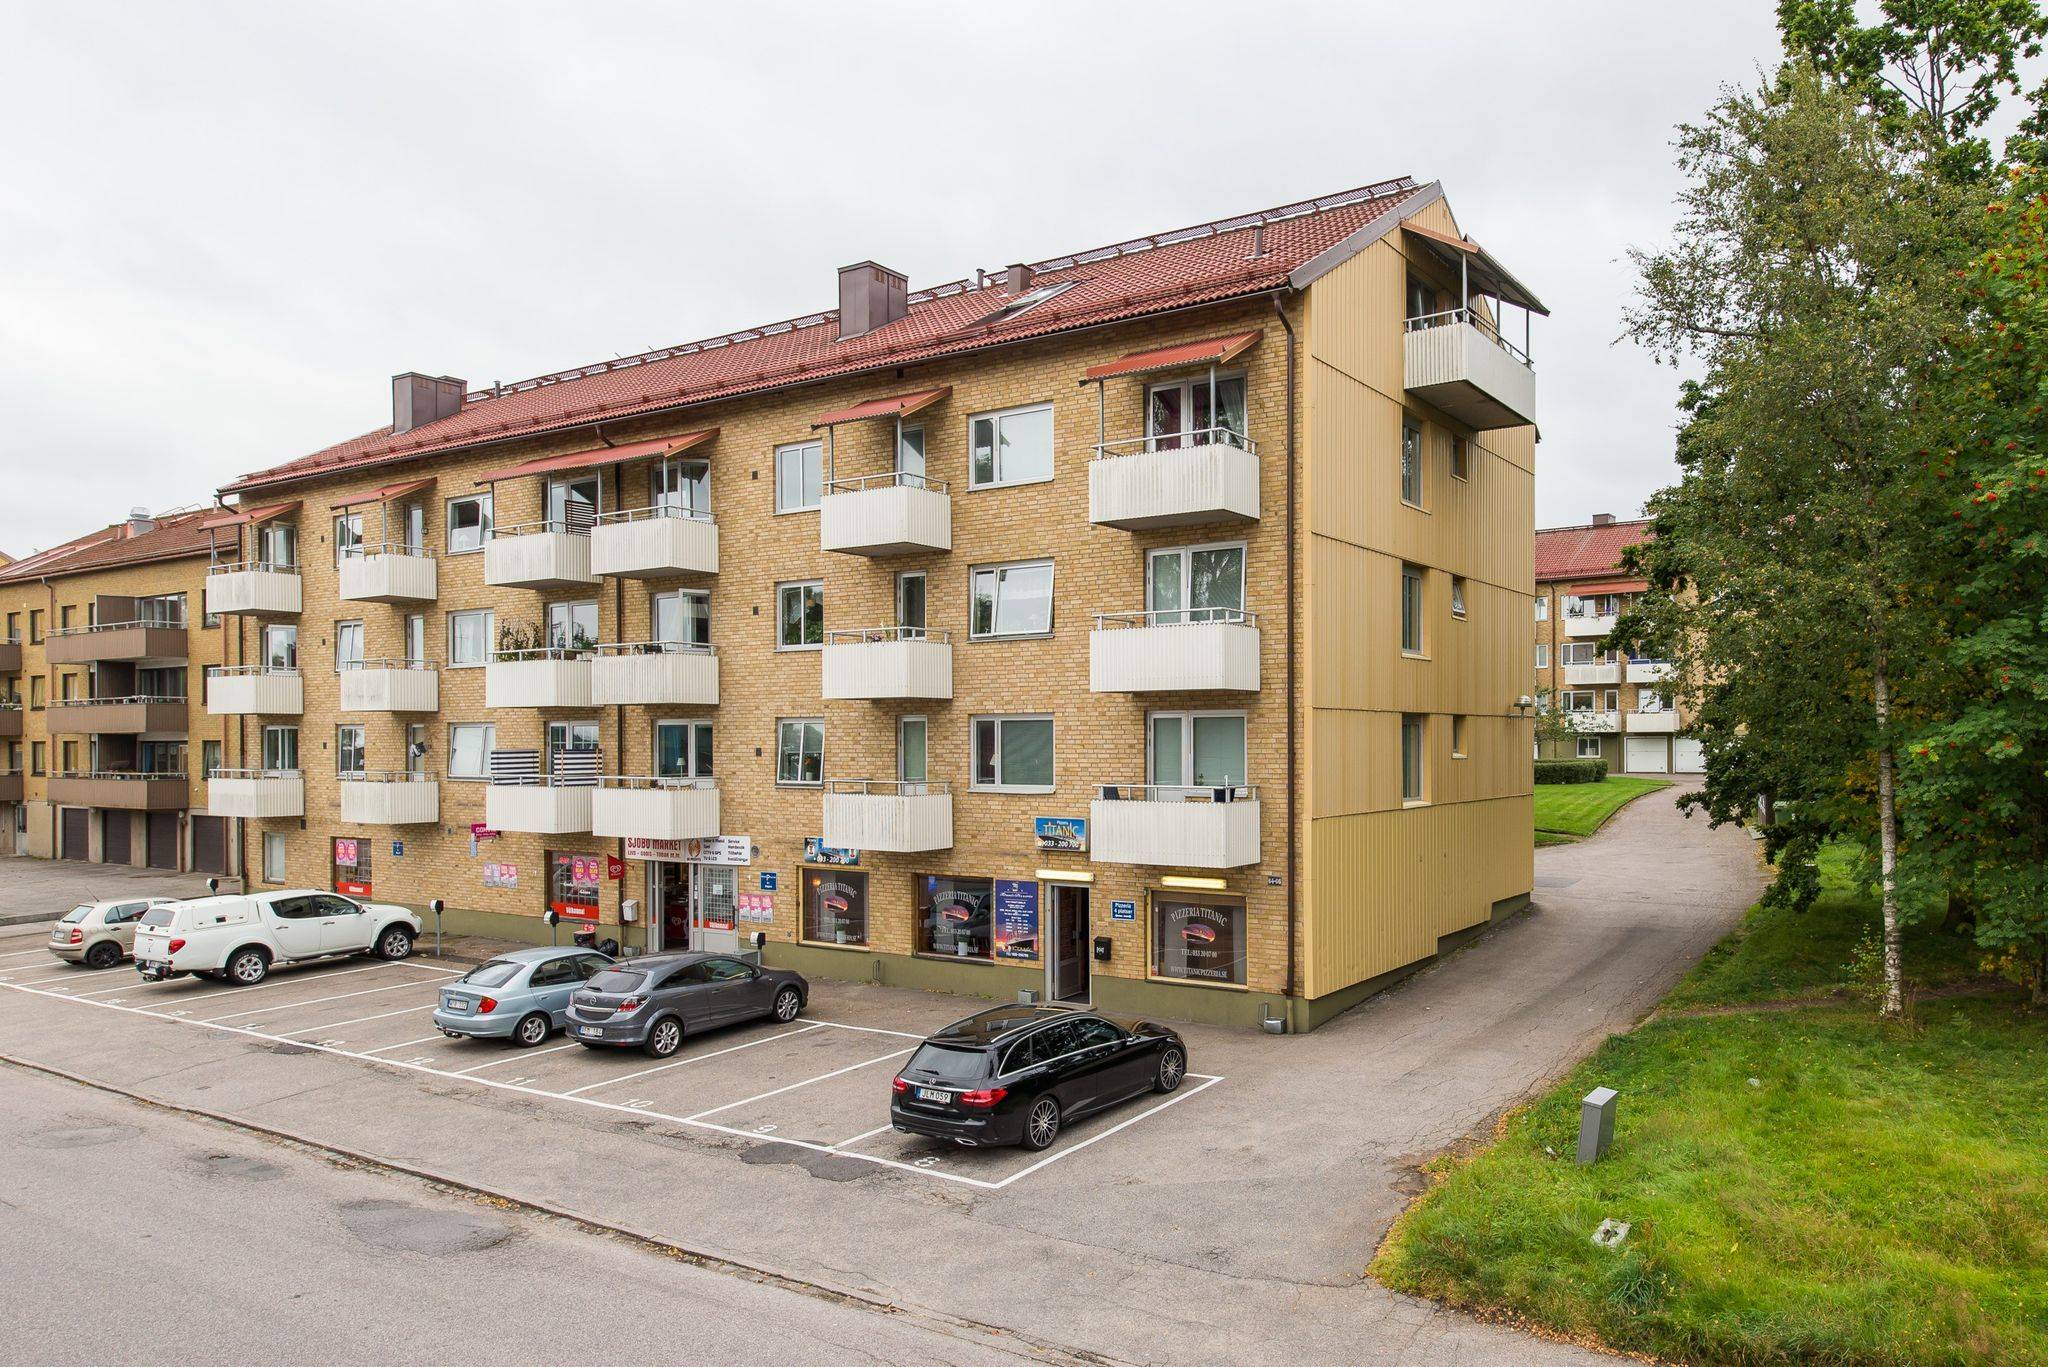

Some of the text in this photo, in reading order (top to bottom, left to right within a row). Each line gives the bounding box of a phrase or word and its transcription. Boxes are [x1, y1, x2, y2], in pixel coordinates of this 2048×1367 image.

[1043, 822, 1079, 836] TITANIC
[652, 839, 681, 851] MARKET
[933, 890, 978, 908] PIZZERIA TITANIC
[1170, 907, 1228, 927] PIZZERIA TITANIC
[504, 1077, 536, 1086] 11
[922, 1088, 949, 1101] JLM 059
[620, 1098, 654, 1108] 10
[753, 1124, 778, 1133] 9
[914, 1156, 940, 1167] 8
